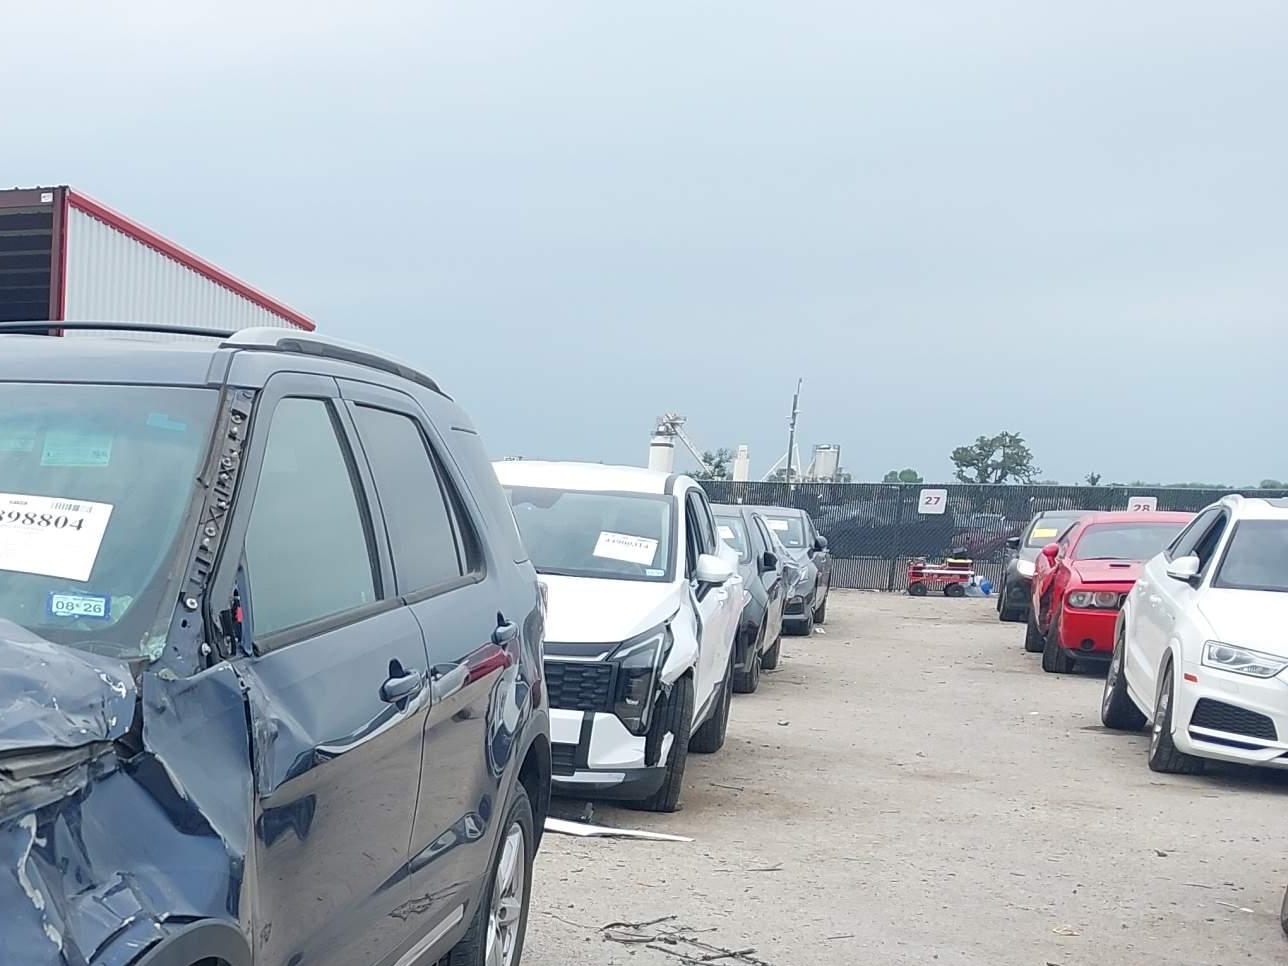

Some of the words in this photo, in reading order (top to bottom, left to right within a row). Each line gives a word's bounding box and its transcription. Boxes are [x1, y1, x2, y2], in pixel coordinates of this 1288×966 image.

[924, 496, 941, 505] 27
[1133, 504, 1151, 512] 28
[55, 600, 75, 611] 08
[83, 602, 102, 614] 26
